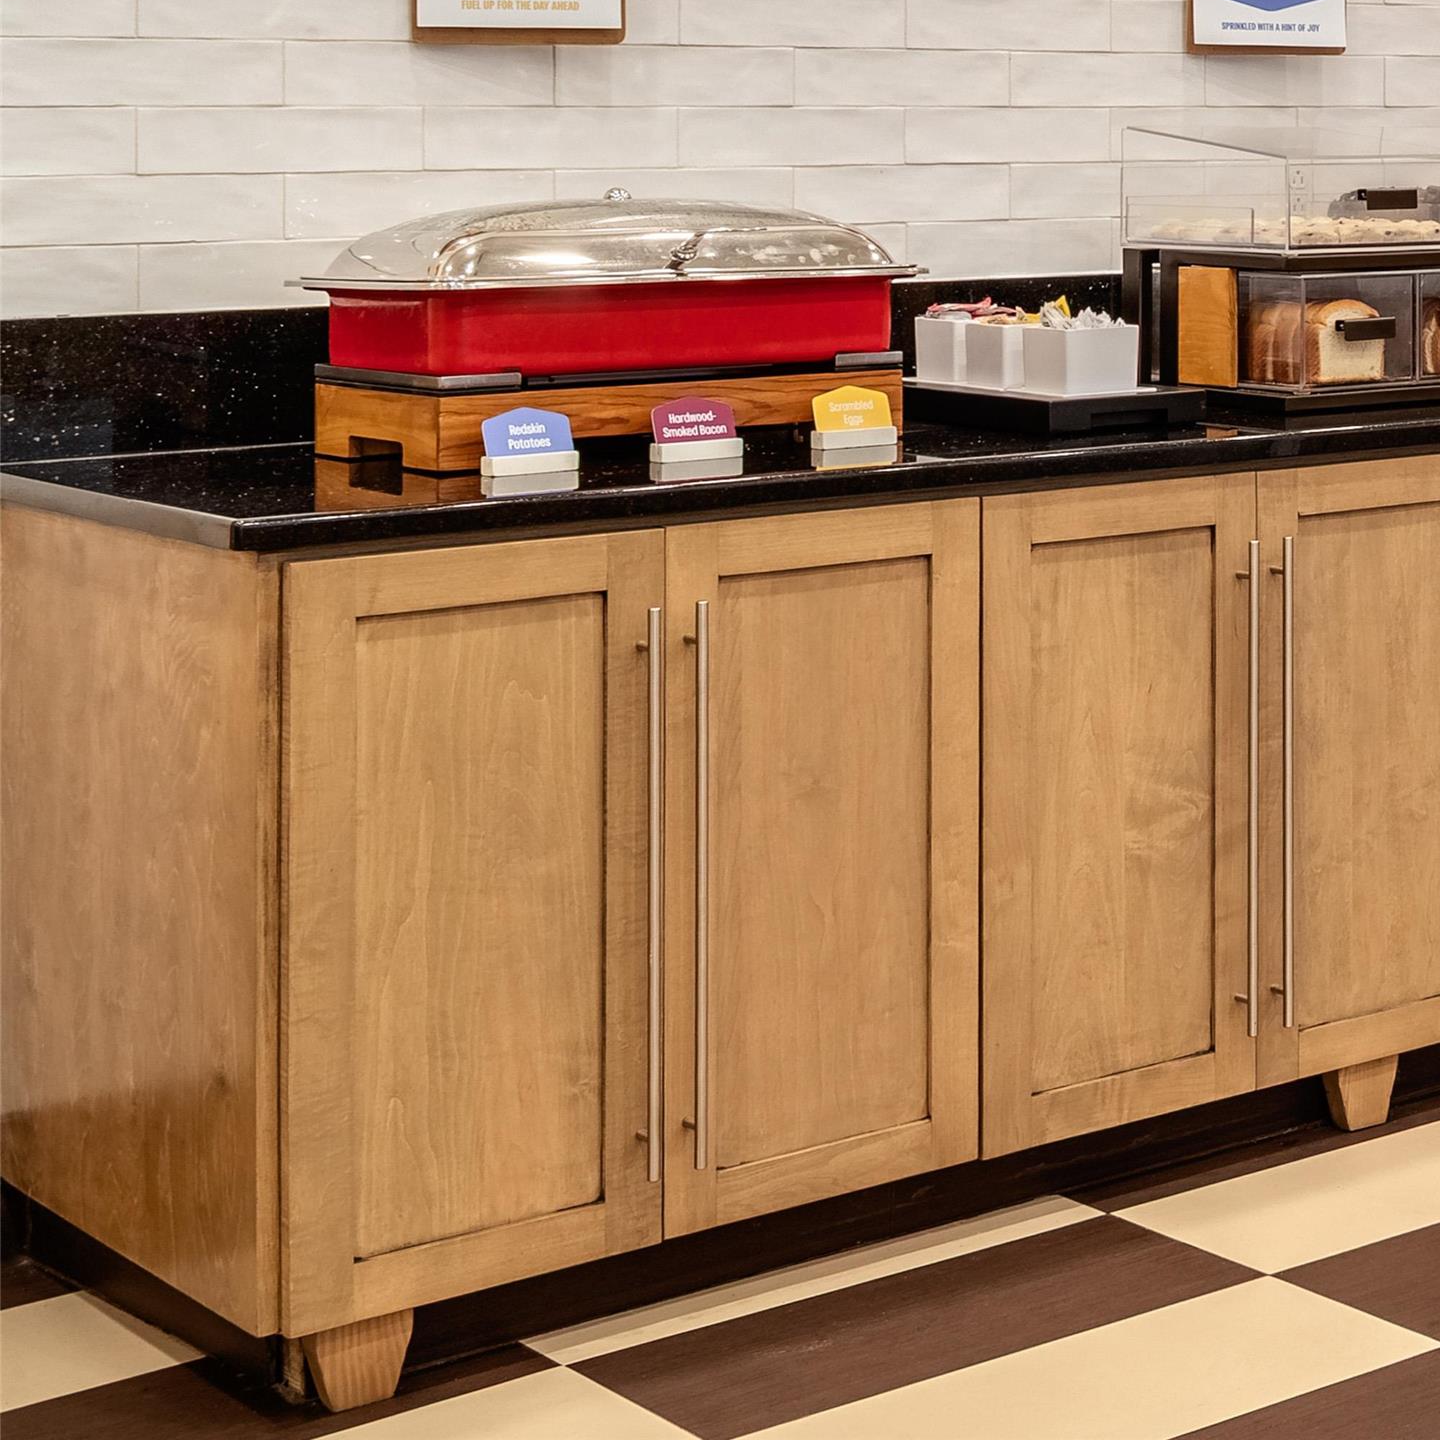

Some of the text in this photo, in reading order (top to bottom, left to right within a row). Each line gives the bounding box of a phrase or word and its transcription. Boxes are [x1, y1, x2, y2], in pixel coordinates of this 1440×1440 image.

[460, 0, 580, 12] FUEL UP FOR THE DAY AHEAD
[1221, 21, 1256, 31] SPRINKLED
[1257, 22, 1274, 31] WITH
[1281, 23, 1296, 32] HINT
[1297, 23, 1306, 32] OF
[1307, 23, 1320, 33] JOY
[668, 410, 717, 424] Hardwood-
[508, 422, 546, 436] Redskin
[662, 423, 728, 439] Smoked Bacon
[507, 436, 552, 450] Potatoes
